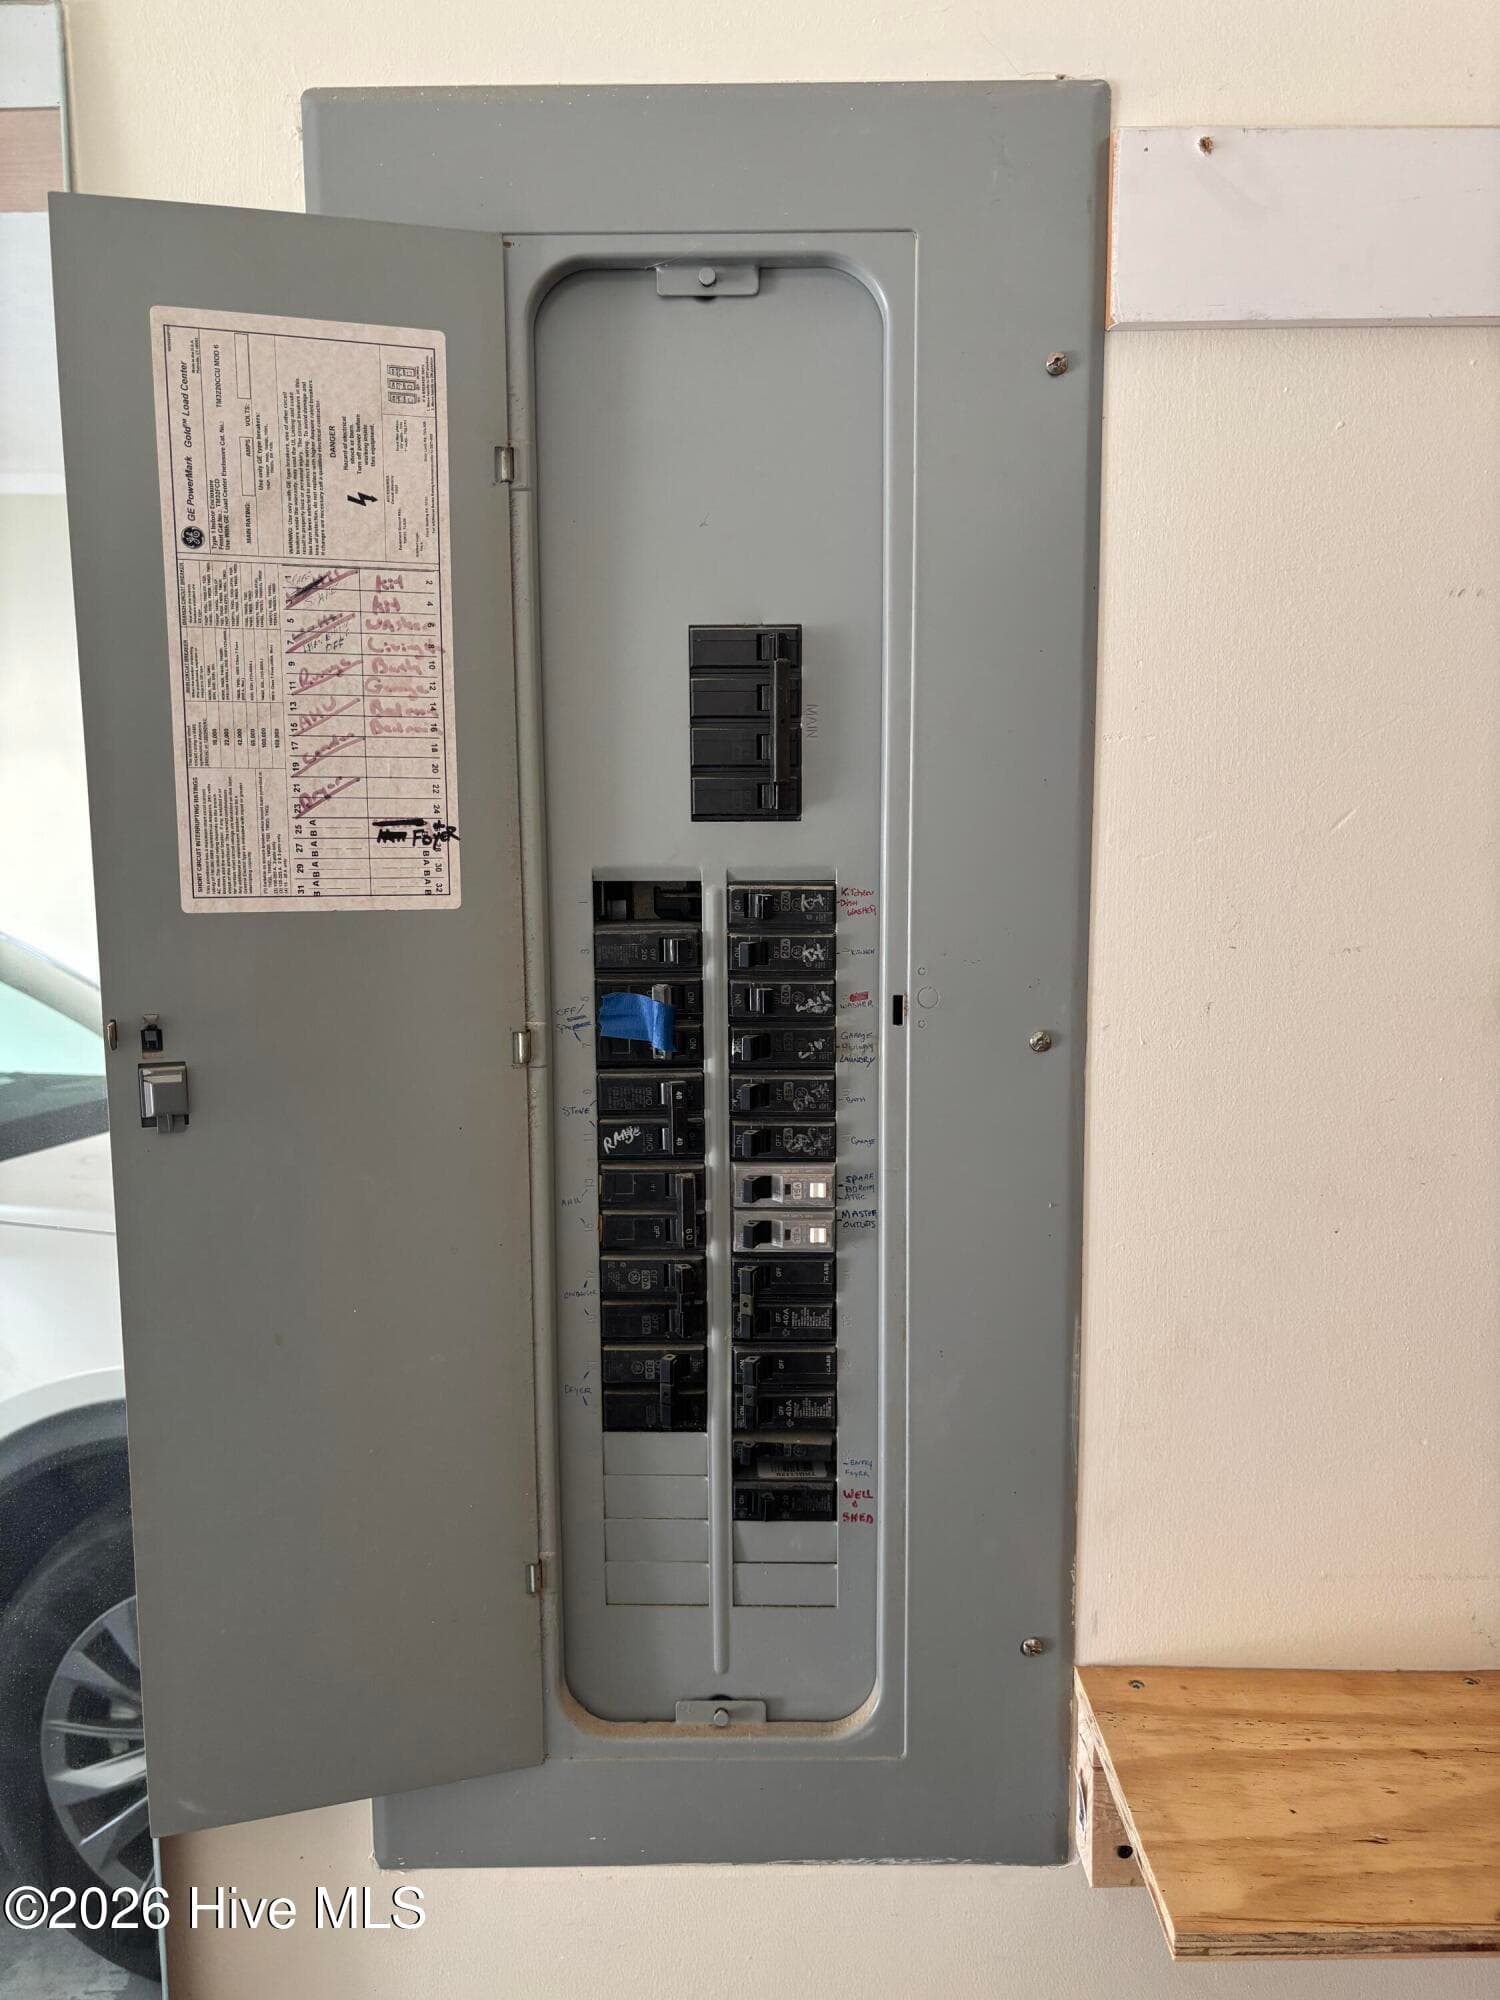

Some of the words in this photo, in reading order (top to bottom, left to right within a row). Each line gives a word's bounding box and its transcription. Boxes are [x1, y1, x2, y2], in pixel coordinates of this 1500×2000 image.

[213, 350, 221, 366] MOD
[179, 360, 190, 391] Center
[181, 393, 191, 418] Load
[329, 425, 337, 458] DANGER
[256, 455, 263, 464] GE
[184, 456, 195, 506] PowerMark
[186, 508, 196, 522] GE
[223, 514, 229, 524] GE
[428, 660, 436, 670] 10
[289, 681, 297, 690] 11
[429, 682, 437, 691] 12
[290, 701, 297, 711] 13
[430, 702, 437, 713] 14
[806, 703, 819, 739] MAIN
[290, 722, 298, 732] 15
[430, 723, 438, 733] 16
[291, 741, 299, 751] 17
[431, 743, 438, 753] 18
[292, 762, 300, 771] 19
[432, 763, 439, 774] 20
[293, 783, 301, 793] 21
[432, 784, 440, 794] 22
[294, 803, 302, 814] 23
[433, 804, 440, 815] 24
[194, 804, 202, 847] INTERRUPTING
[295, 824, 302, 835] 25
[296, 843, 304, 853] 27
[195, 847, 203, 872] CIRCUIT
[297, 863, 304, 874] 29
[435, 863, 442, 873] 30
[298, 884, 305, 895] 31
[435, 882, 443, 892] 32
[842, 1489, 874, 1499] WELL
[842, 1511, 875, 1524] SHED
